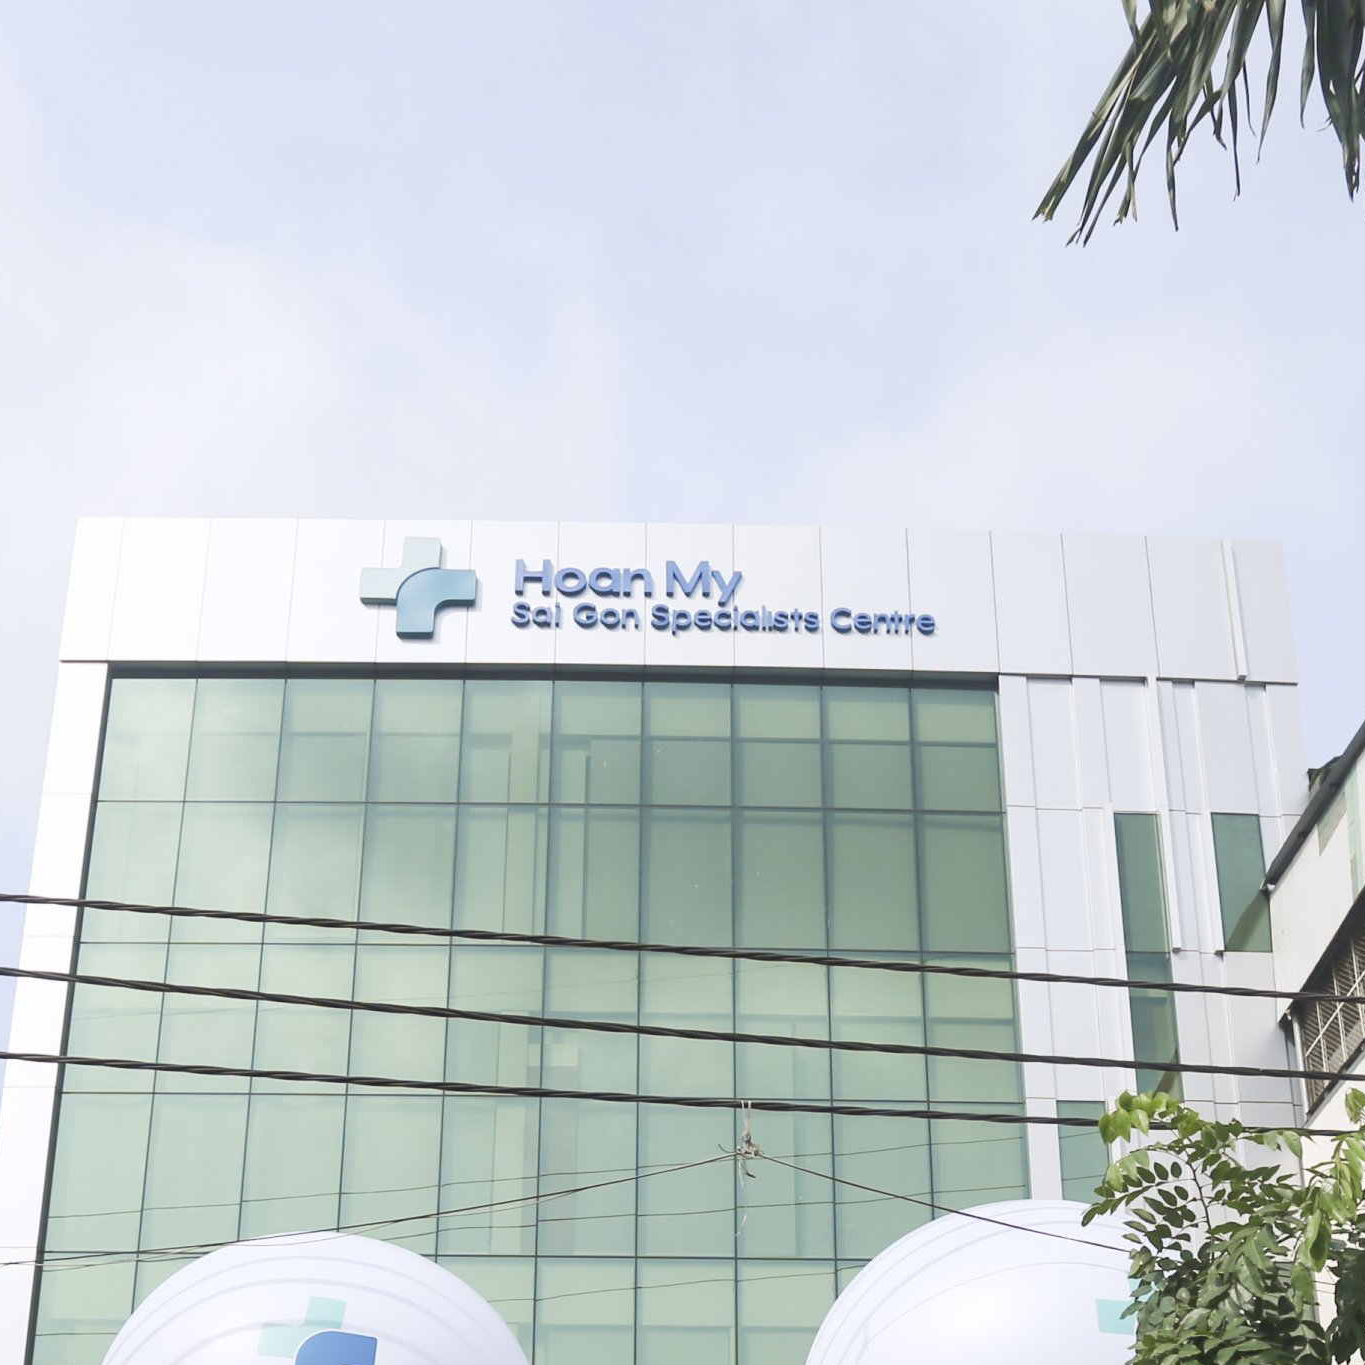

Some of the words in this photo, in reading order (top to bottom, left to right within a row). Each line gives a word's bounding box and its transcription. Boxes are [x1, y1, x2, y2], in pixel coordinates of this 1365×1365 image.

[515, 559, 652, 598] Hoan
[666, 560, 743, 605] My
[511, 602, 561, 629] Sai
[573, 603, 641, 630] Gon
[650, 604, 821, 636] Specialists
[830, 607, 937, 635] Centre
